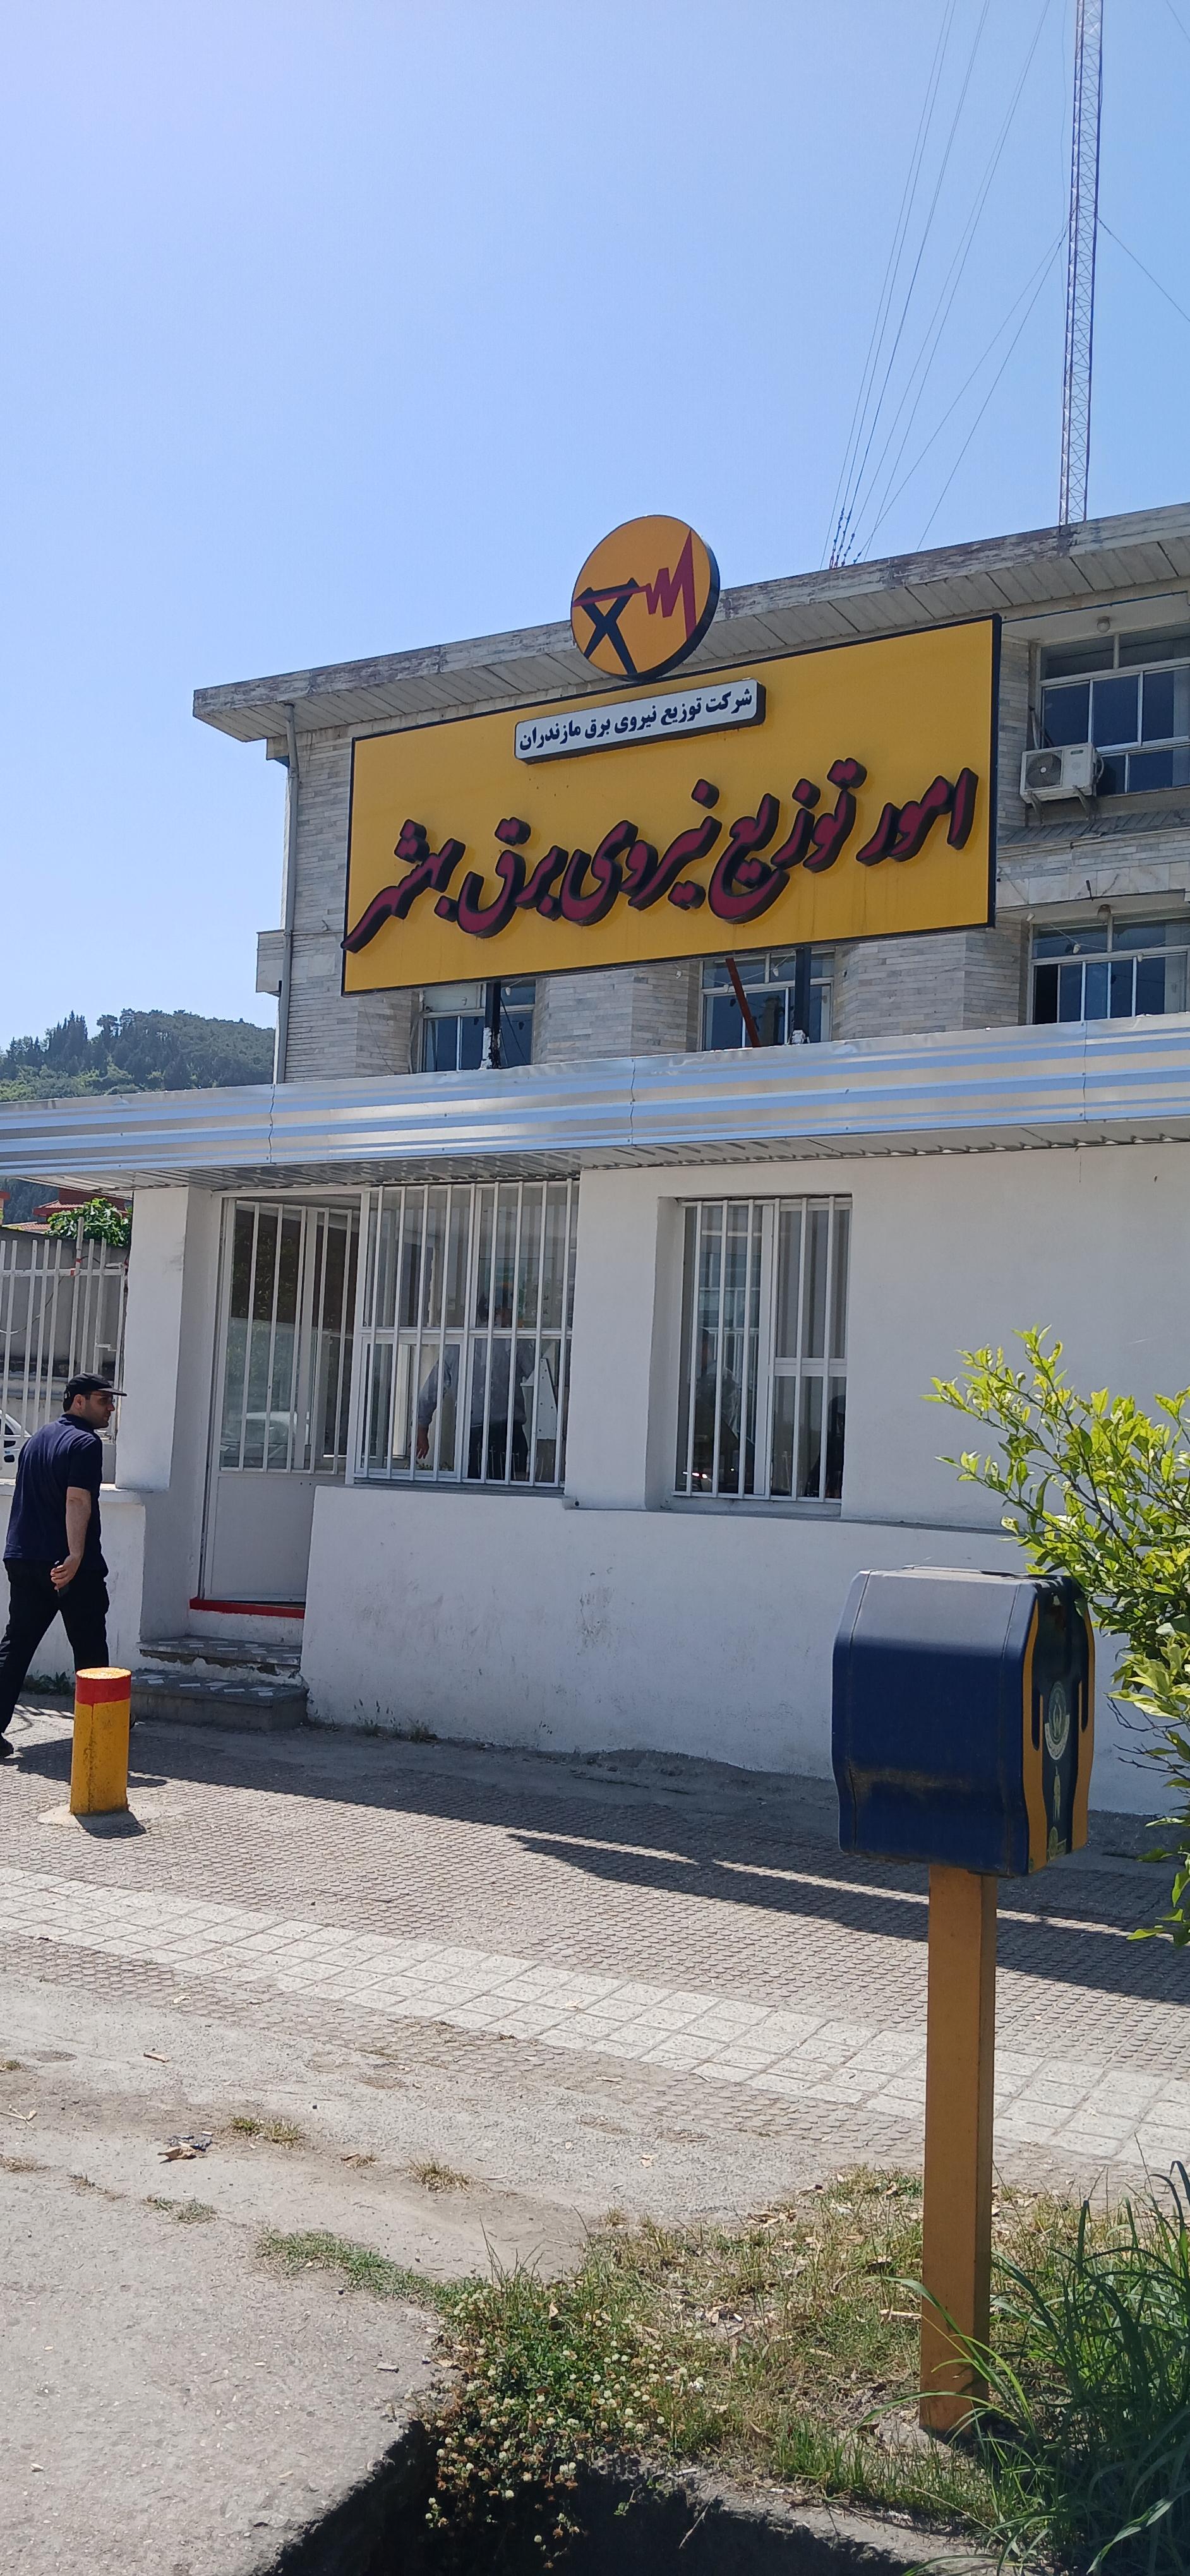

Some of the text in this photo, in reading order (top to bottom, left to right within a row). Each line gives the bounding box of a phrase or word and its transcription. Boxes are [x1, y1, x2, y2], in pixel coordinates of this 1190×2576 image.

[519, 688, 753, 751] شرکت توزیع نیروی برق مازندران
[340, 757, 980, 954] امور توزیع نیروی برق بهشهر
